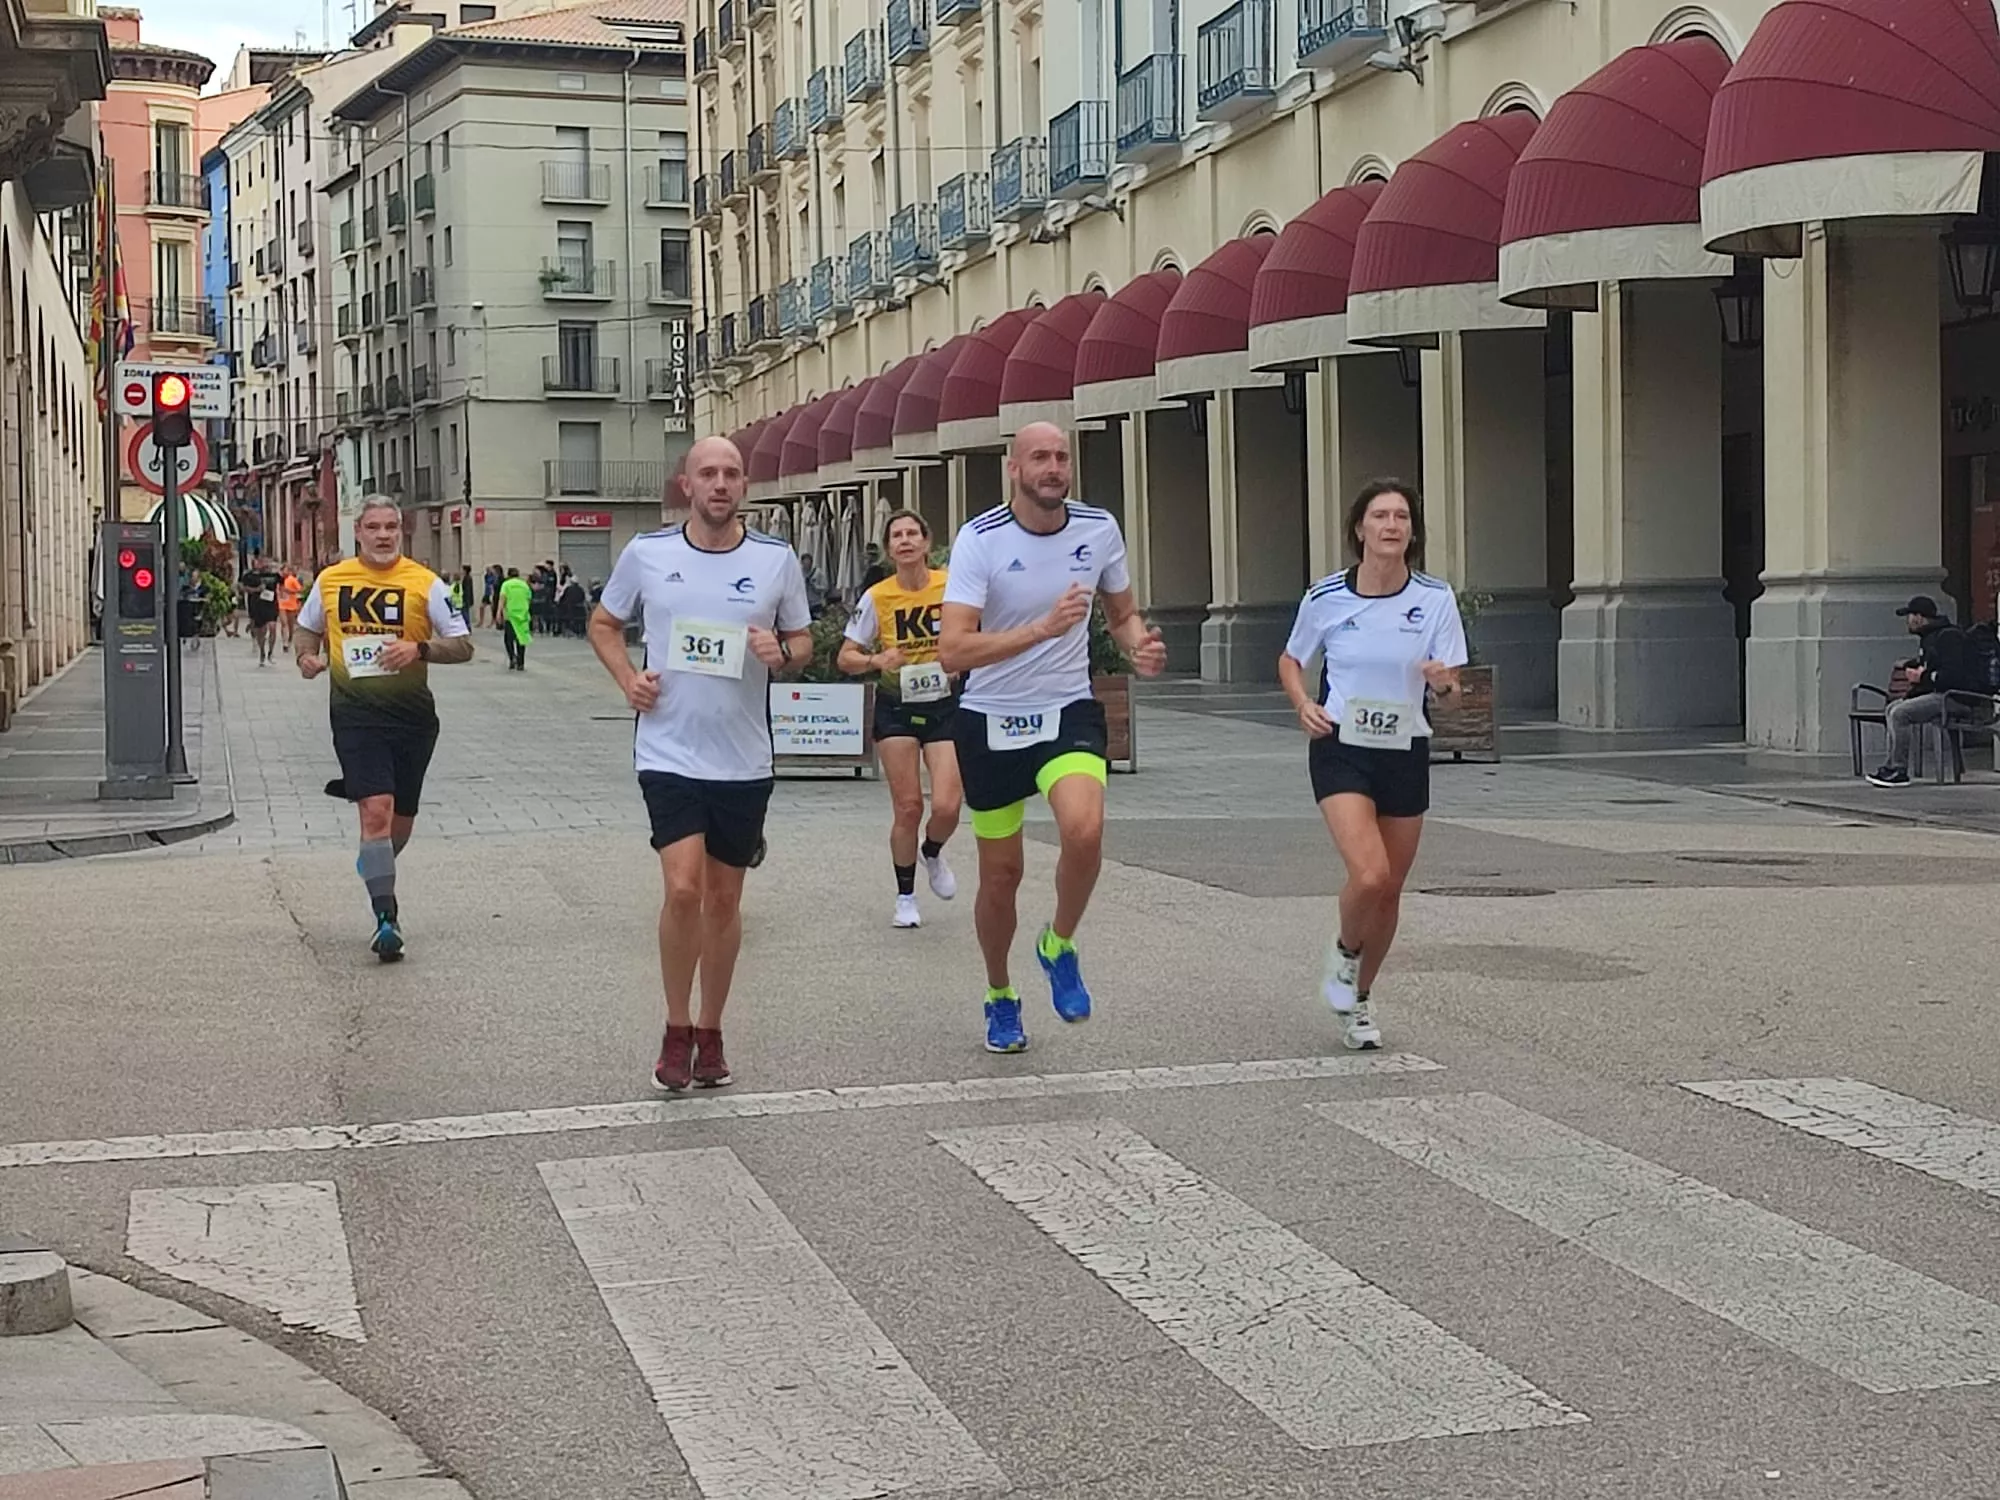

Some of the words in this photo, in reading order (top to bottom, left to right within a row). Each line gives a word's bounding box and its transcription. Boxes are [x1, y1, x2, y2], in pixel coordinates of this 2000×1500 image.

[123, 369, 151, 377] ZONA
[672, 319, 686, 414] HOSTAL
[571, 515, 598, 525] GAES
[681, 634, 724, 656] 361
[909, 674, 940, 691] 363
[1354, 708, 1399, 728] 362
